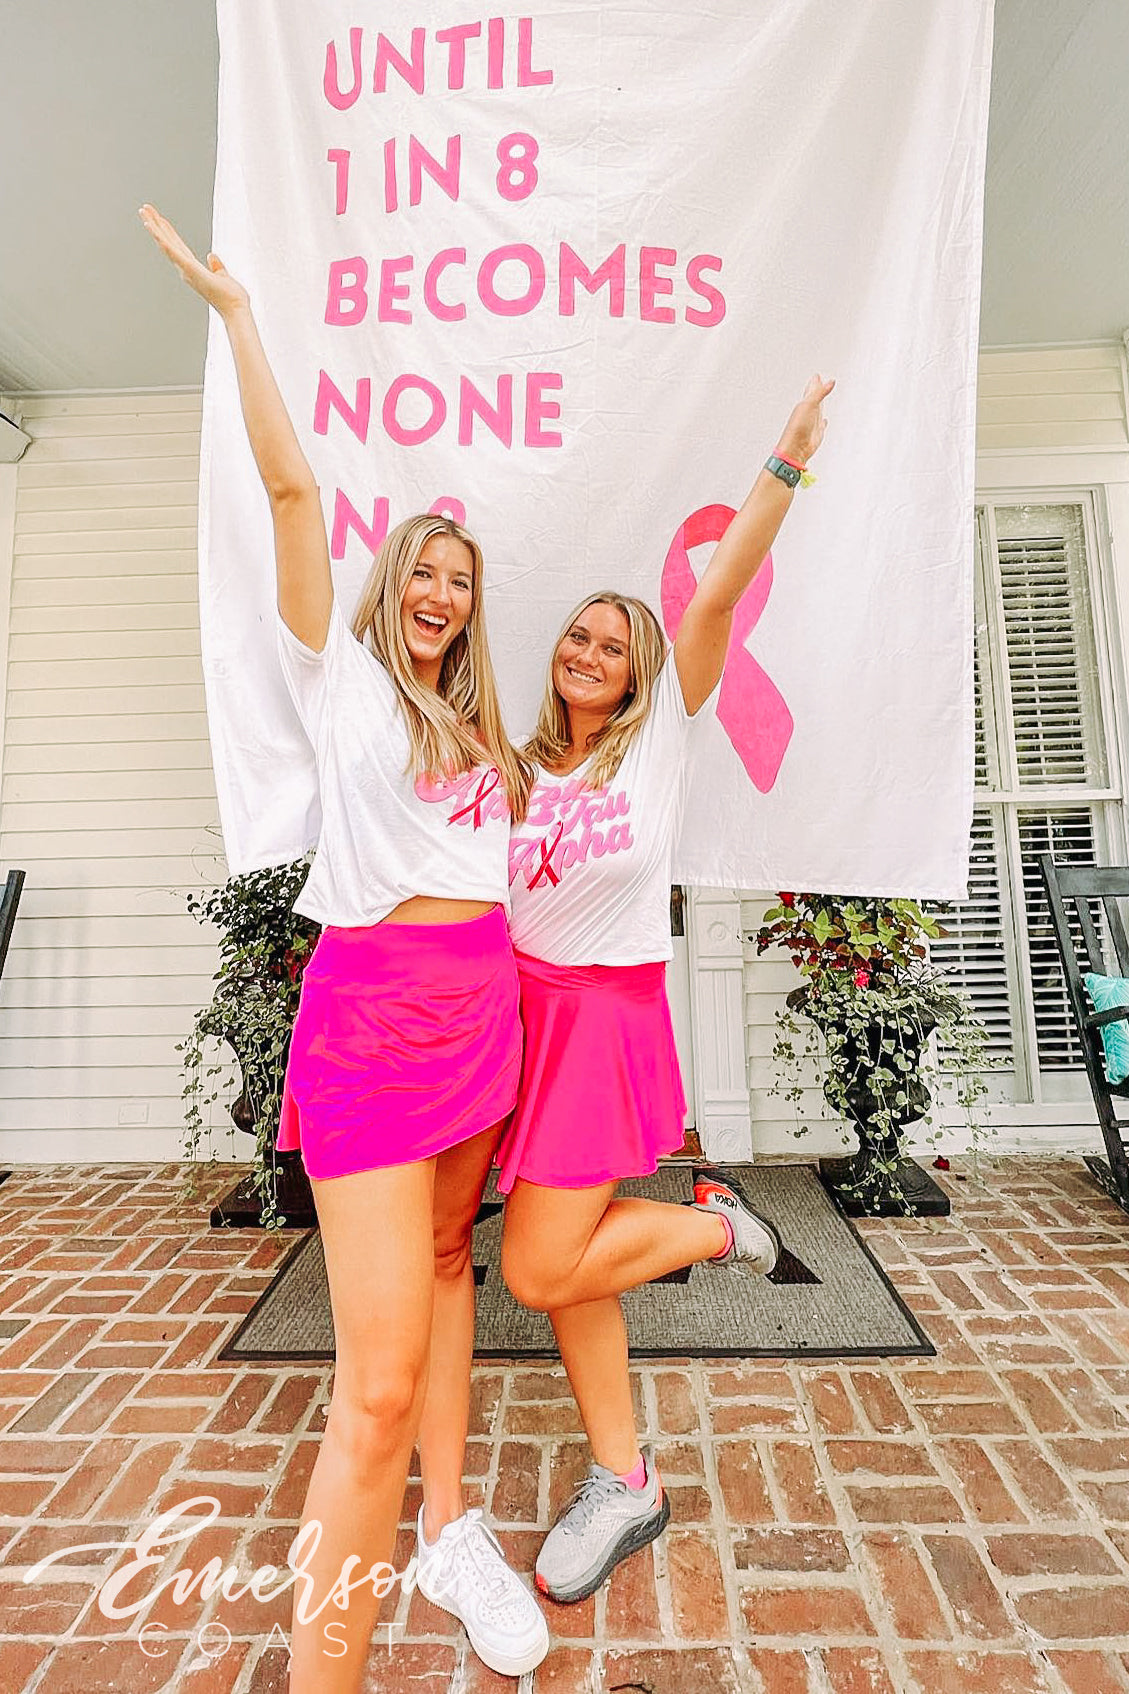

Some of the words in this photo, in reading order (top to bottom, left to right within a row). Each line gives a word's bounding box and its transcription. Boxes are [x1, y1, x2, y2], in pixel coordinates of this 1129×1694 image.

[324, 17, 554, 111] UNTIL
[327, 148, 351, 216] 1
[384, 134, 461, 214] IN
[496, 132, 539, 201] 8
[324, 241, 726, 328] BECOMES
[313, 369, 563, 450] NONE
[509, 822, 634, 888] Apha
[714, 1193, 738, 1211] HOKA
